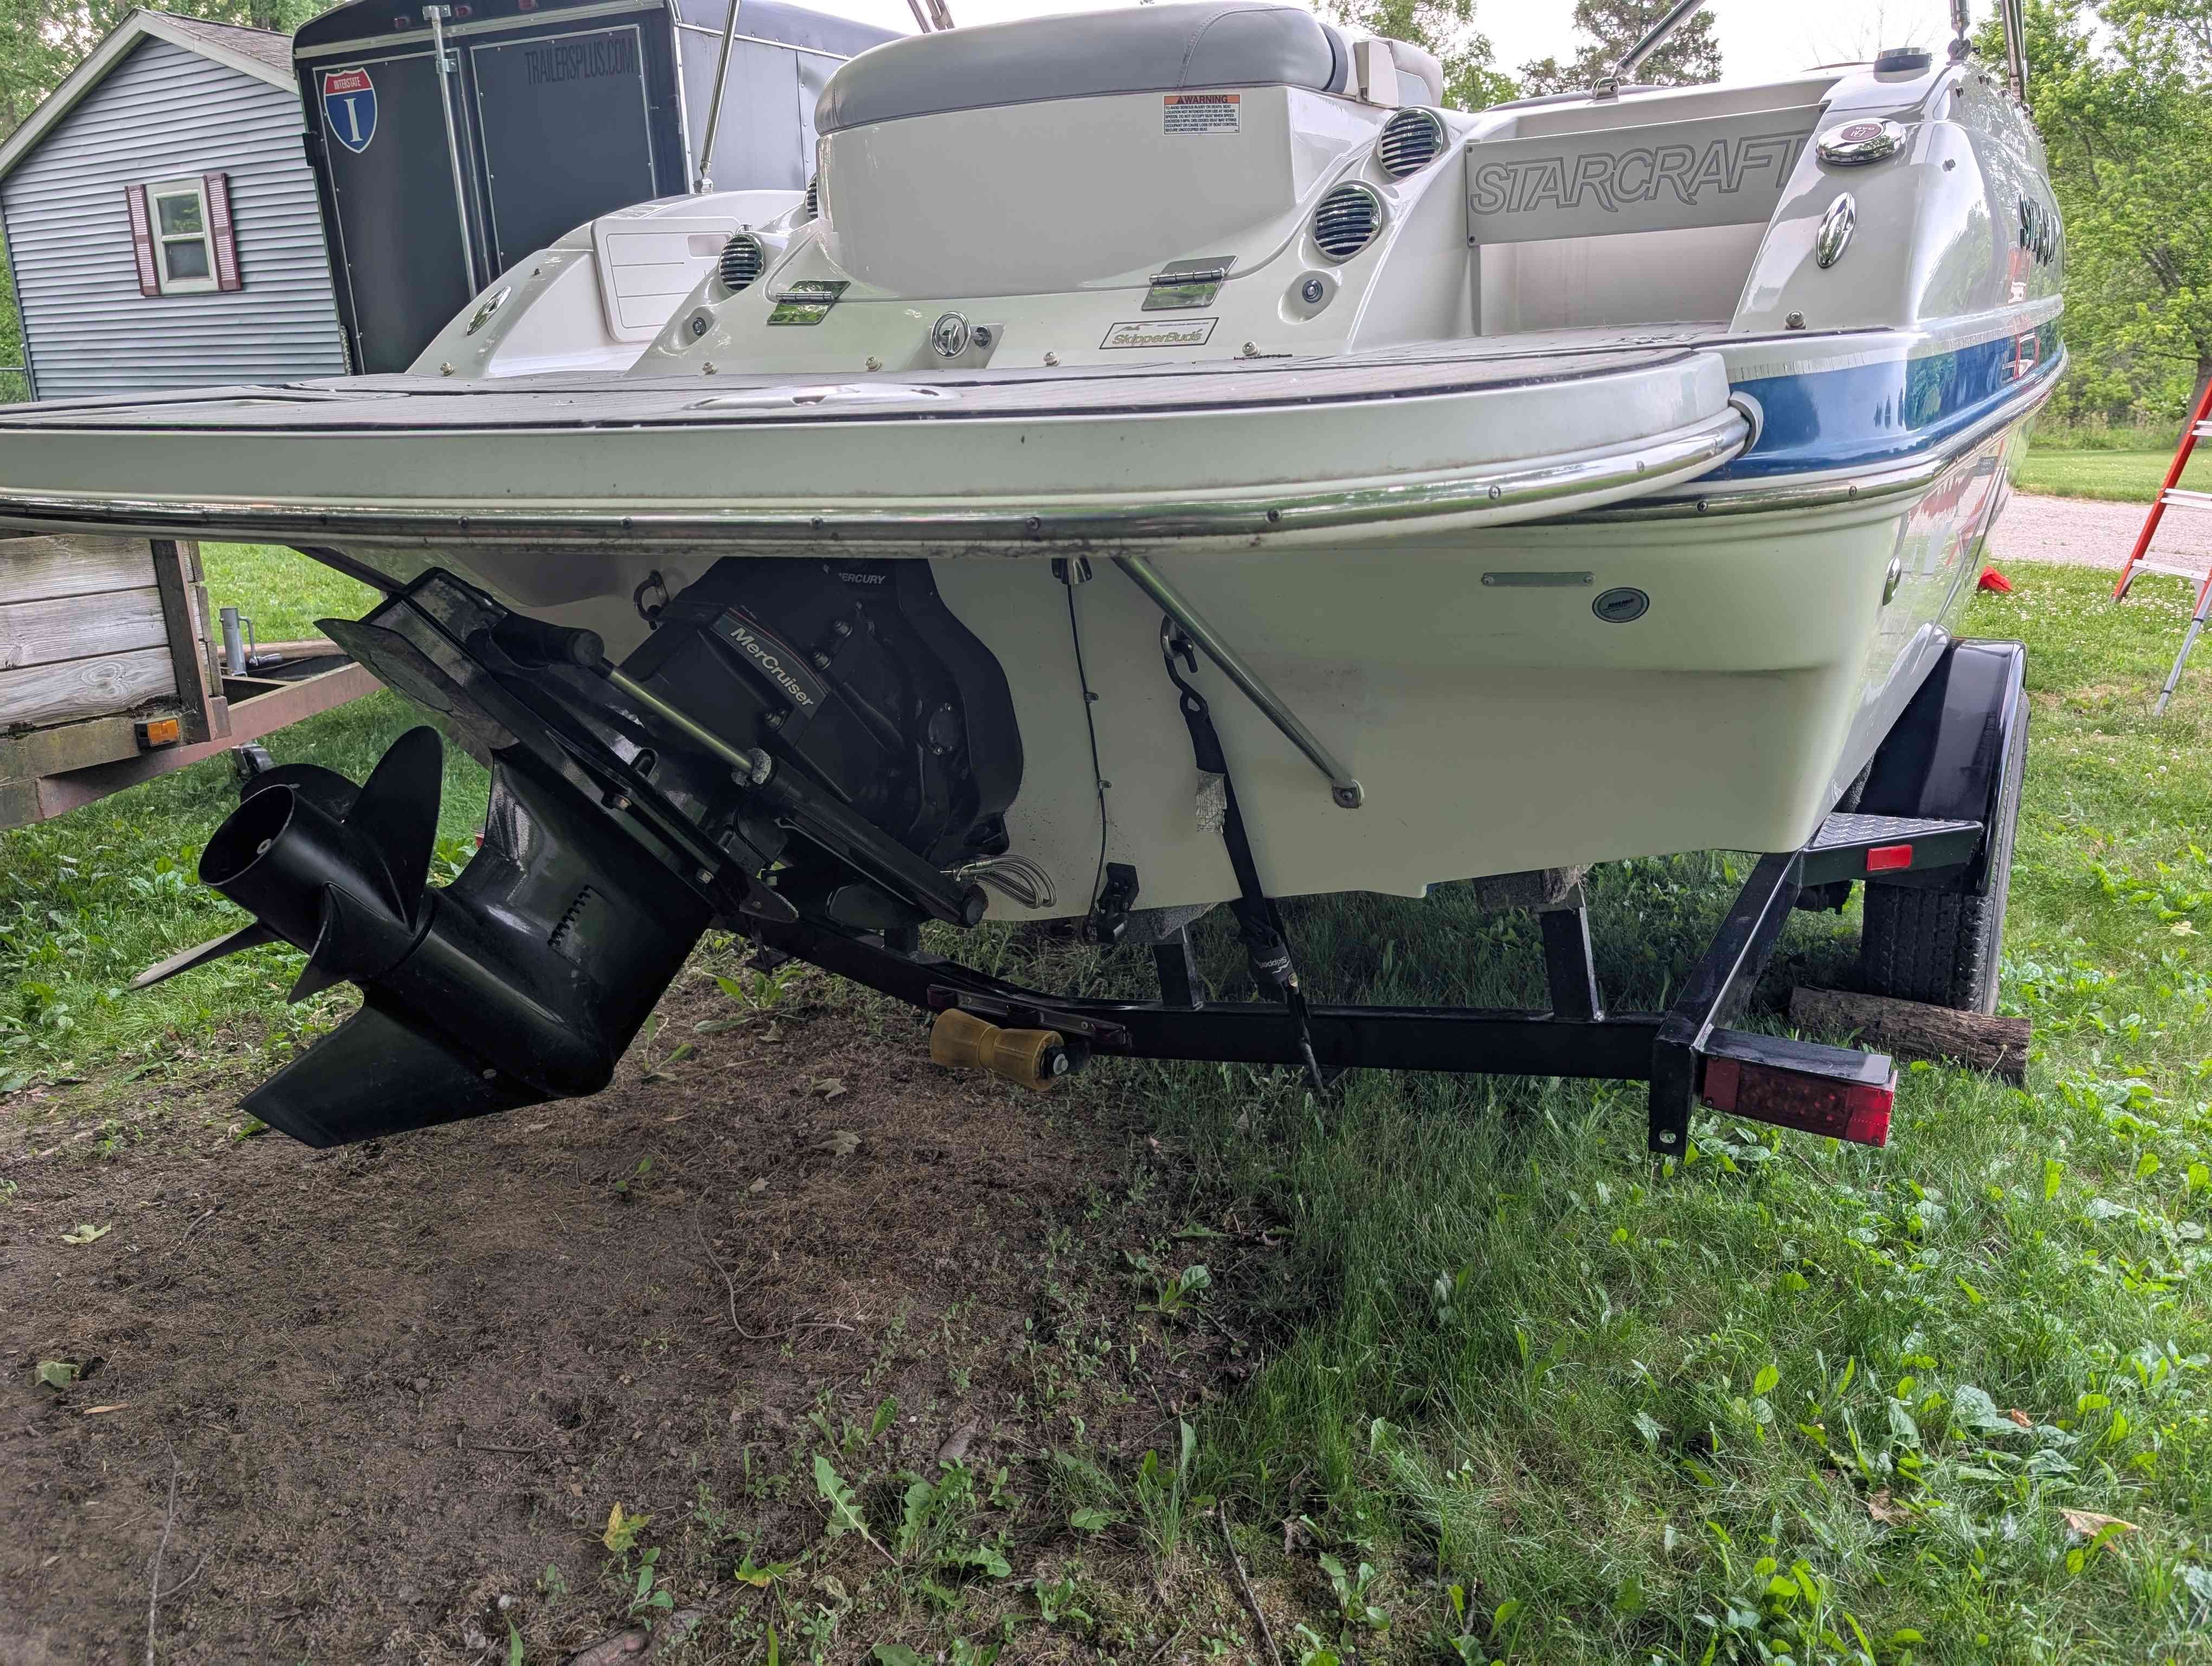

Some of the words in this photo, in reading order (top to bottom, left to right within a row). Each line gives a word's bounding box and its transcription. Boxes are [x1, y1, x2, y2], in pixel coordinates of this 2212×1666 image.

[333, 75, 362, 91] INTERSTATE
[525, 37, 634, 85] TRAILERSPLUS.COM
[344, 98, 363, 142] I
[1184, 95, 1228, 104] WARNING
[1471, 128, 1814, 215] STARCRAFT
[730, 627, 813, 706] MerCruiser
